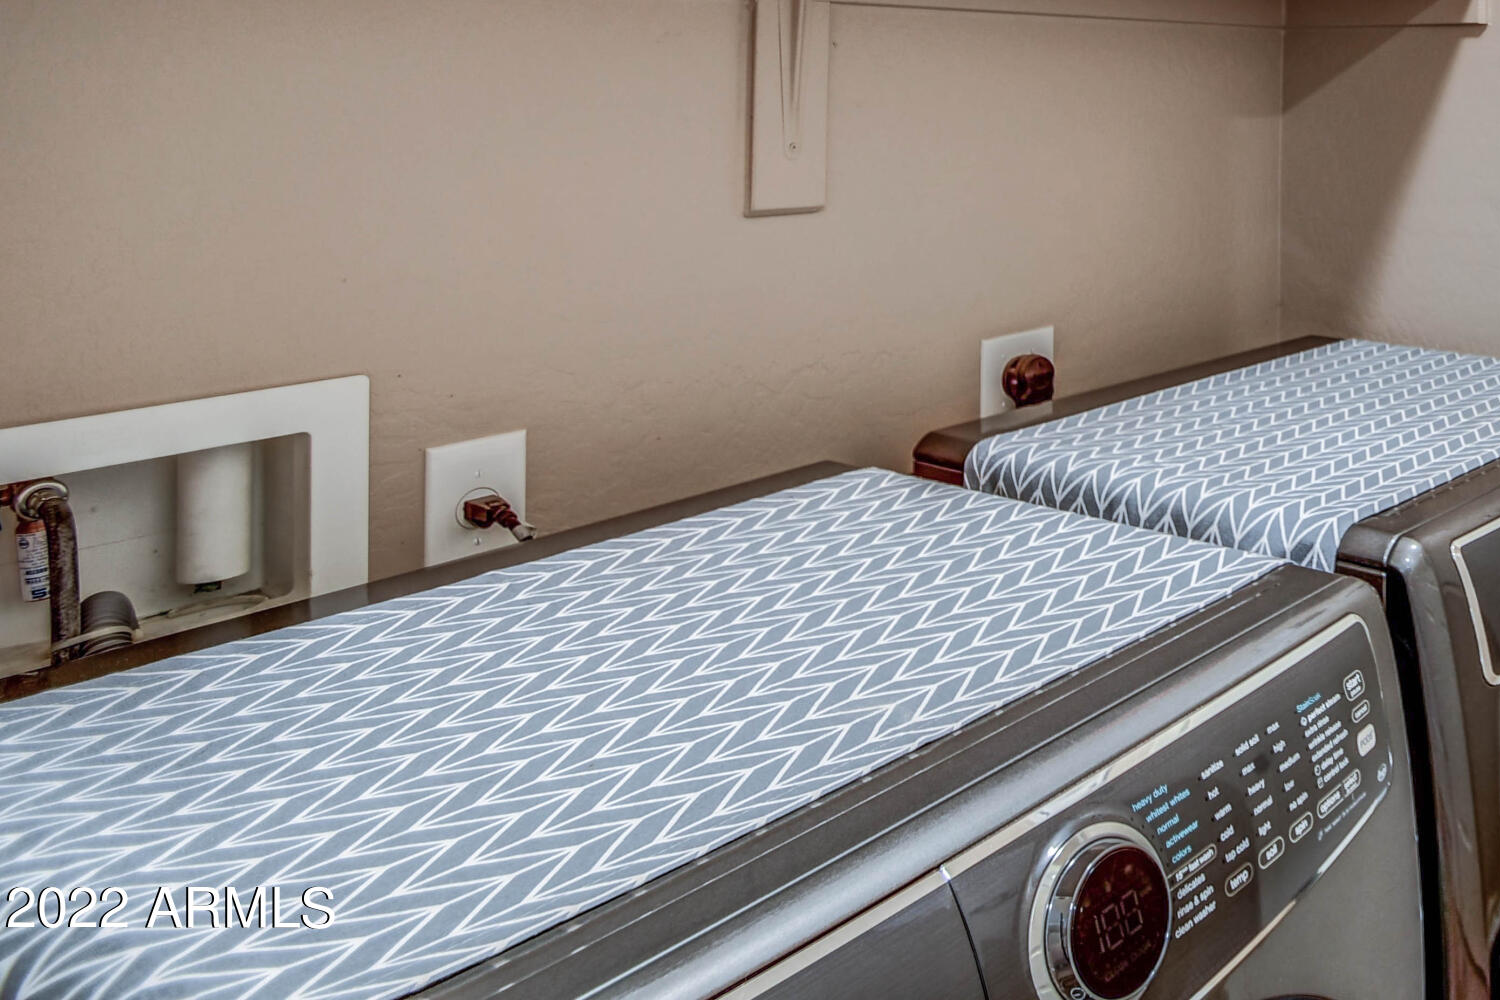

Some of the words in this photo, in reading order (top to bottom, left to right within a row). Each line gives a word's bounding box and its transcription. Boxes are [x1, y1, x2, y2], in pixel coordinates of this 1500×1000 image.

[1131, 793, 1154, 813] heavy
[1152, 783, 1168, 799] duty
[1156, 813, 1180, 836] normal
[1171, 845, 1193, 864] colors
